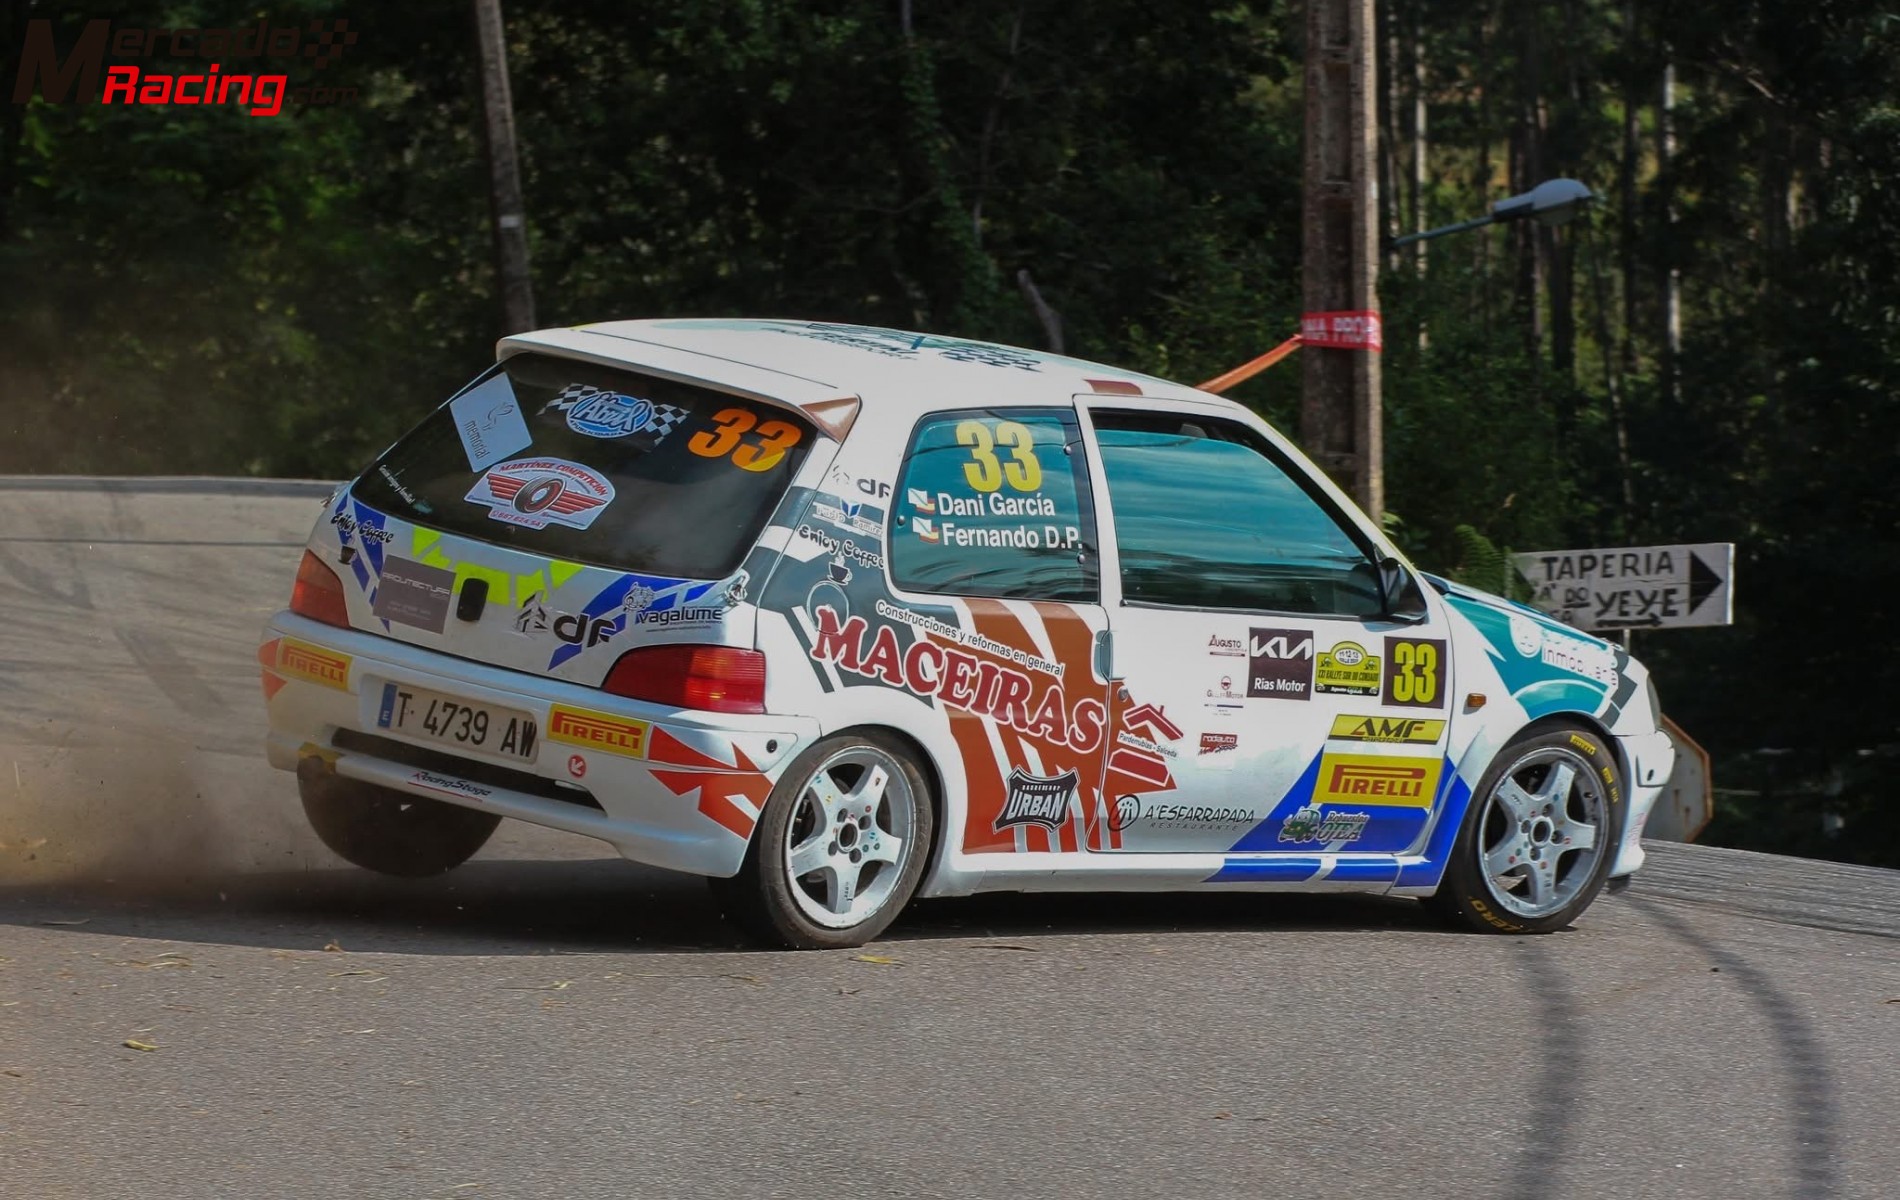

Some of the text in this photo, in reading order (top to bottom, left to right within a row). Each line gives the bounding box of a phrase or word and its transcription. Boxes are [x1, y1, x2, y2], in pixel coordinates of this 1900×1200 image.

[464, 420, 491, 459] memorial
[688, 408, 802, 473] 33
[956, 420, 1043, 493] 33
[937, 492, 1056, 517] Dani García
[330, 512, 395, 545] Enjoy Coffee
[800, 524, 838, 554] Enjoy
[942, 523, 1084, 550] Fernando D.P.
[1541, 551, 1674, 581] TAPERIA
[637, 605, 723, 626] vagalume
[1564, 587, 1589, 603] DO
[1595, 587, 1679, 617] YEYE
[877, 600, 1064, 676] Construcciones y reformas en general
[1208, 634, 1242, 649] AUGUSTO
[1250, 635, 1313, 660] KIA
[281, 645, 346, 683] PIRELLI
[1393, 642, 1437, 703] 33
[811, 607, 1106, 754] MACEIRAS
[1254, 677, 1306, 693] Rias Motor
[398, 691, 538, 758] T 4739 AW
[552, 710, 643, 749] PIRELLI
[1350, 717, 1426, 738] AMF
[1328, 764, 1426, 797] PIRELLI
[1006, 788, 1067, 820] URBAN
[1144, 805, 1255, 824] A'ESFARRAPADA
[1150, 822, 1238, 831] RESTAURANTE
